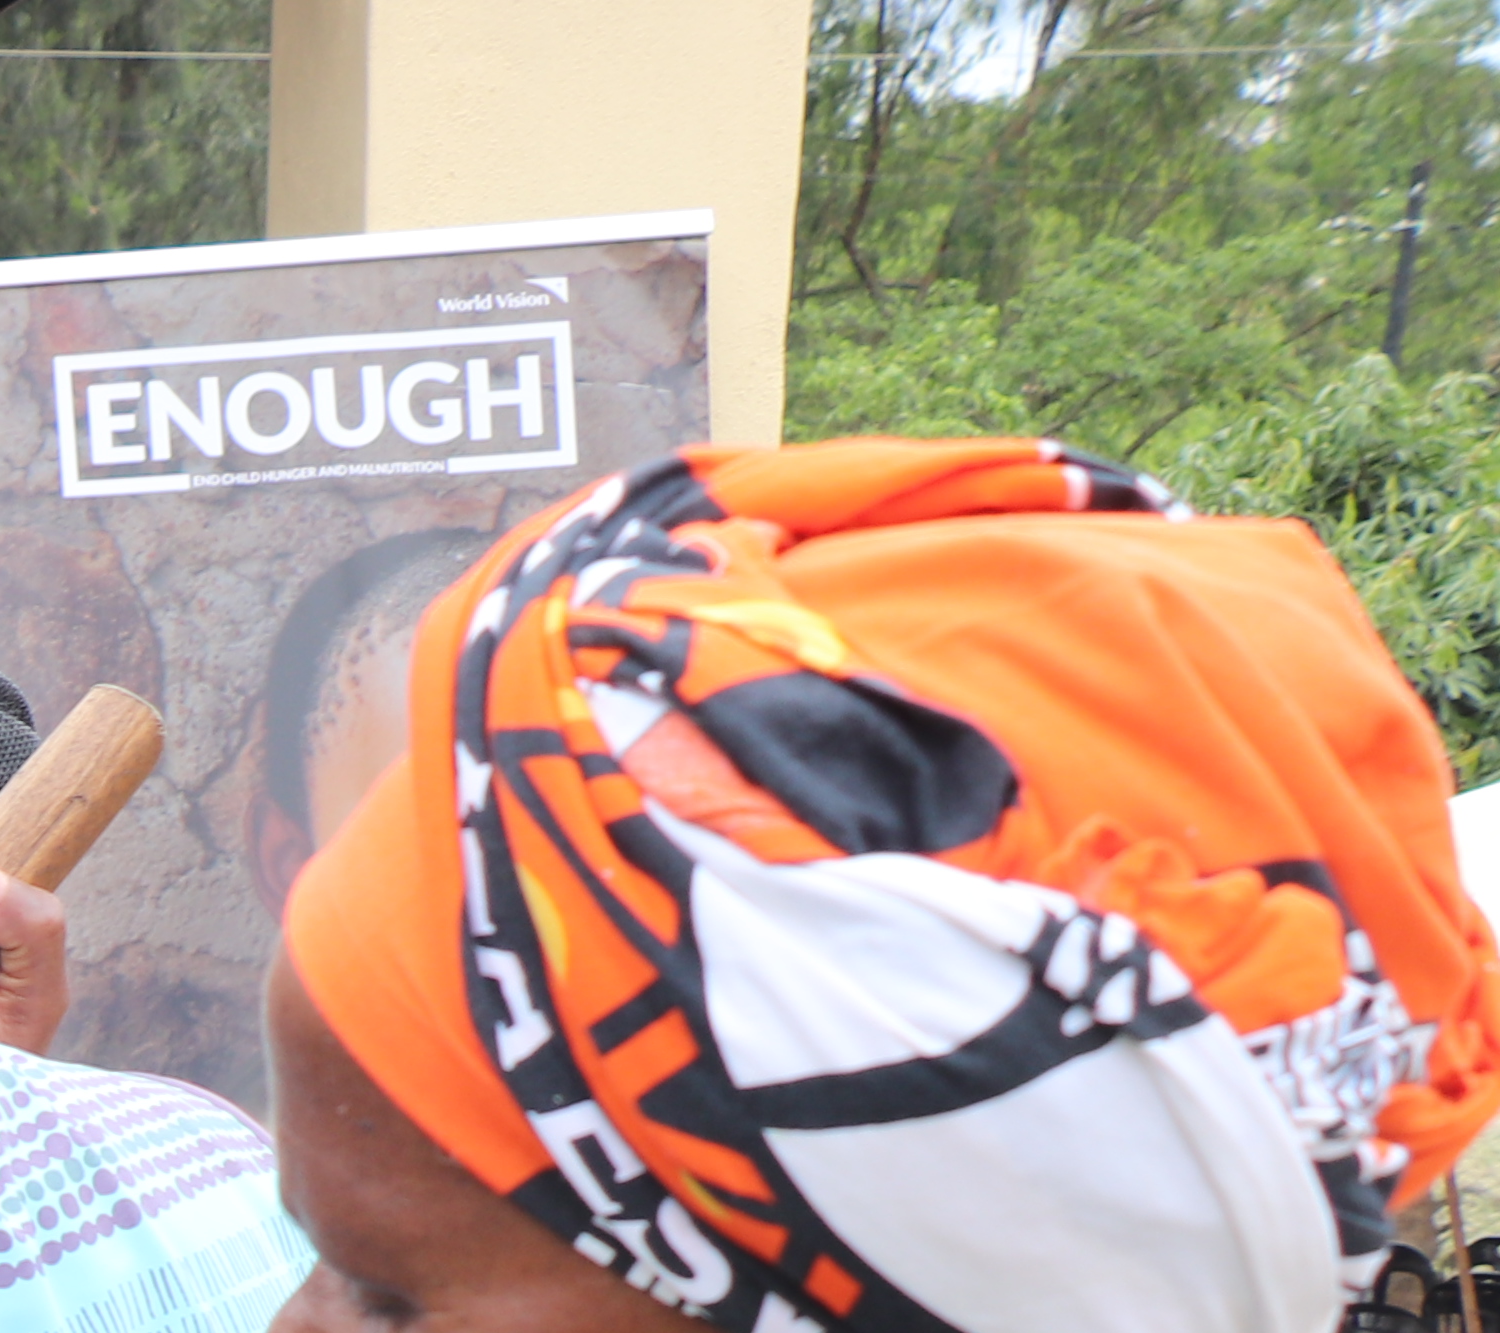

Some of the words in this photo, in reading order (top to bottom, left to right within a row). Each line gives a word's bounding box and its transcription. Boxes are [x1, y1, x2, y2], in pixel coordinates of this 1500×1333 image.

[438, 293, 493, 312] World
[495, 291, 550, 309] Vision
[86, 354, 544, 466] ENOUGH
[193, 474, 221, 487] END
[221, 471, 261, 486] CHILD
[261, 467, 318, 482] HUNGER
[318, 464, 348, 477] AND
[348, 461, 445, 475] MALNUTRITION
